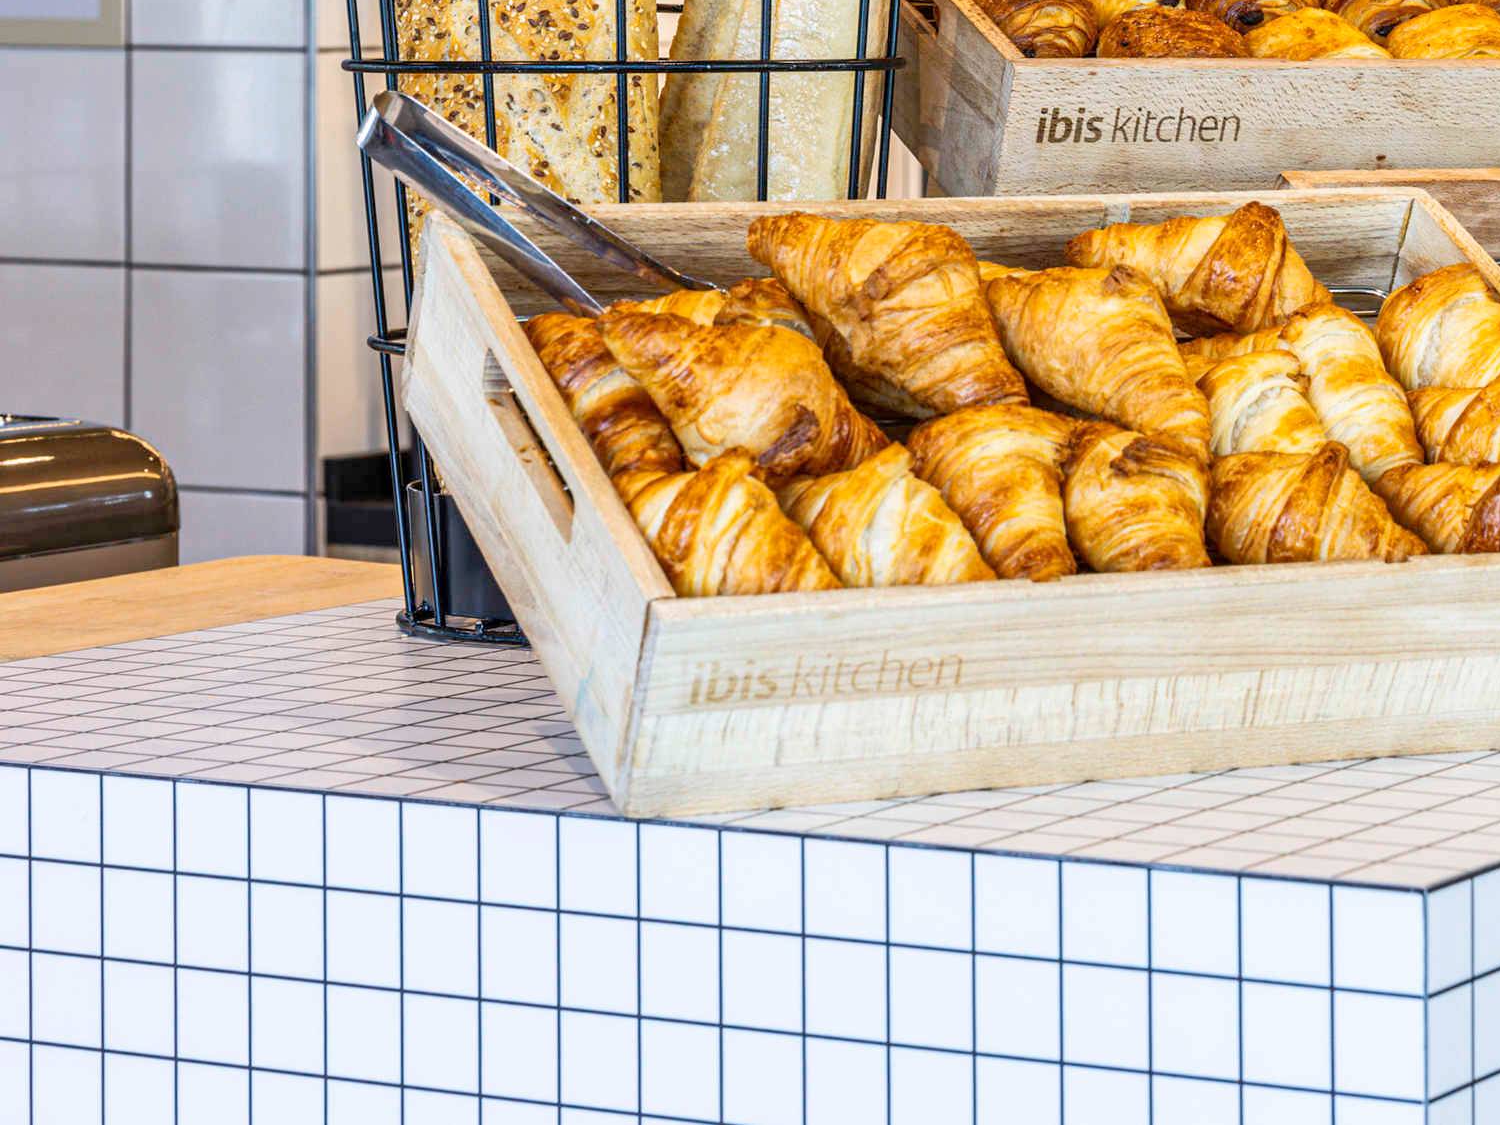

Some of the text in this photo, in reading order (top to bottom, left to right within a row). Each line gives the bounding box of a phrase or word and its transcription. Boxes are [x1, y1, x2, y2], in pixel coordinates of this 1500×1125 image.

[1036, 107, 1241, 143] ibis kitchen
[689, 650, 964, 706] ibis kitchen
